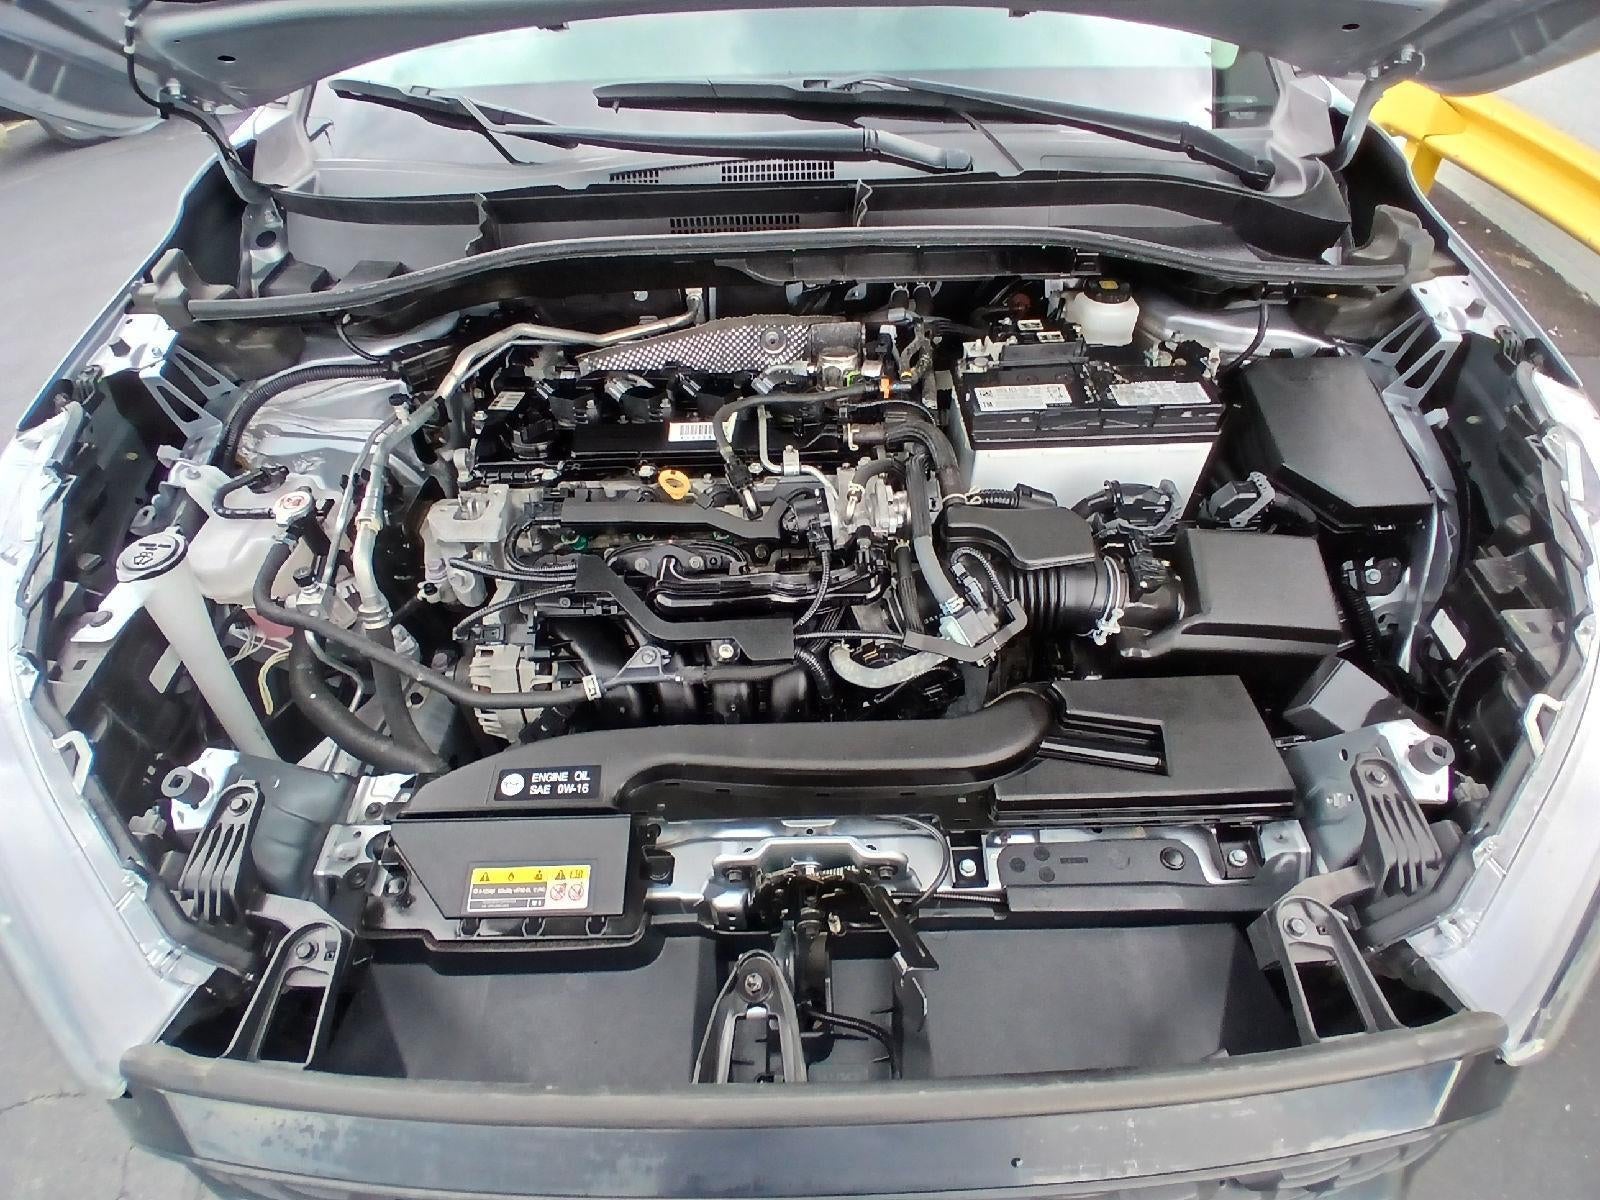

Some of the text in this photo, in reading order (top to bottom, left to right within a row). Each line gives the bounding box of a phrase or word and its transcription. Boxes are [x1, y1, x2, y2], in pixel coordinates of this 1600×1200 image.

[531, 770, 591, 783] ENGINE OIL
[529, 784, 551, 795] SAE
